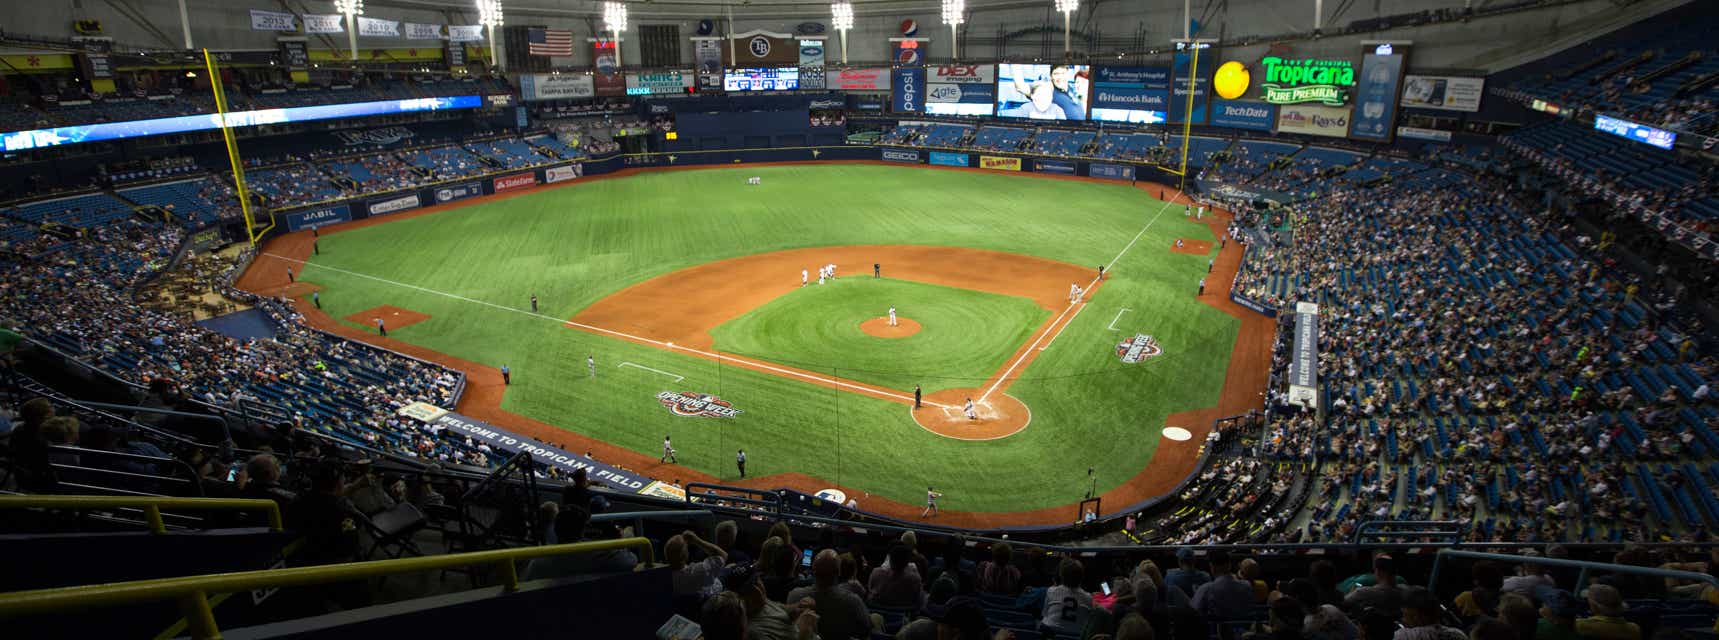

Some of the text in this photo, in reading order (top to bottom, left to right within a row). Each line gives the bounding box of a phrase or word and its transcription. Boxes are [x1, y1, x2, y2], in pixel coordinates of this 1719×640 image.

[755, 40, 767, 54] TB
[937, 65, 977, 77] DEX
[1262, 57, 1353, 86] Tropicana
[902, 72, 915, 111] pepsi
[1267, 88, 1338, 101] PURE PREMIUM
[1107, 94, 1162, 104] Hancock Bank
[883, 150, 918, 161] GEICO
[303, 209, 336, 220] JABIL
[439, 415, 643, 490] WELCOME TO TROPICANA FIELD
